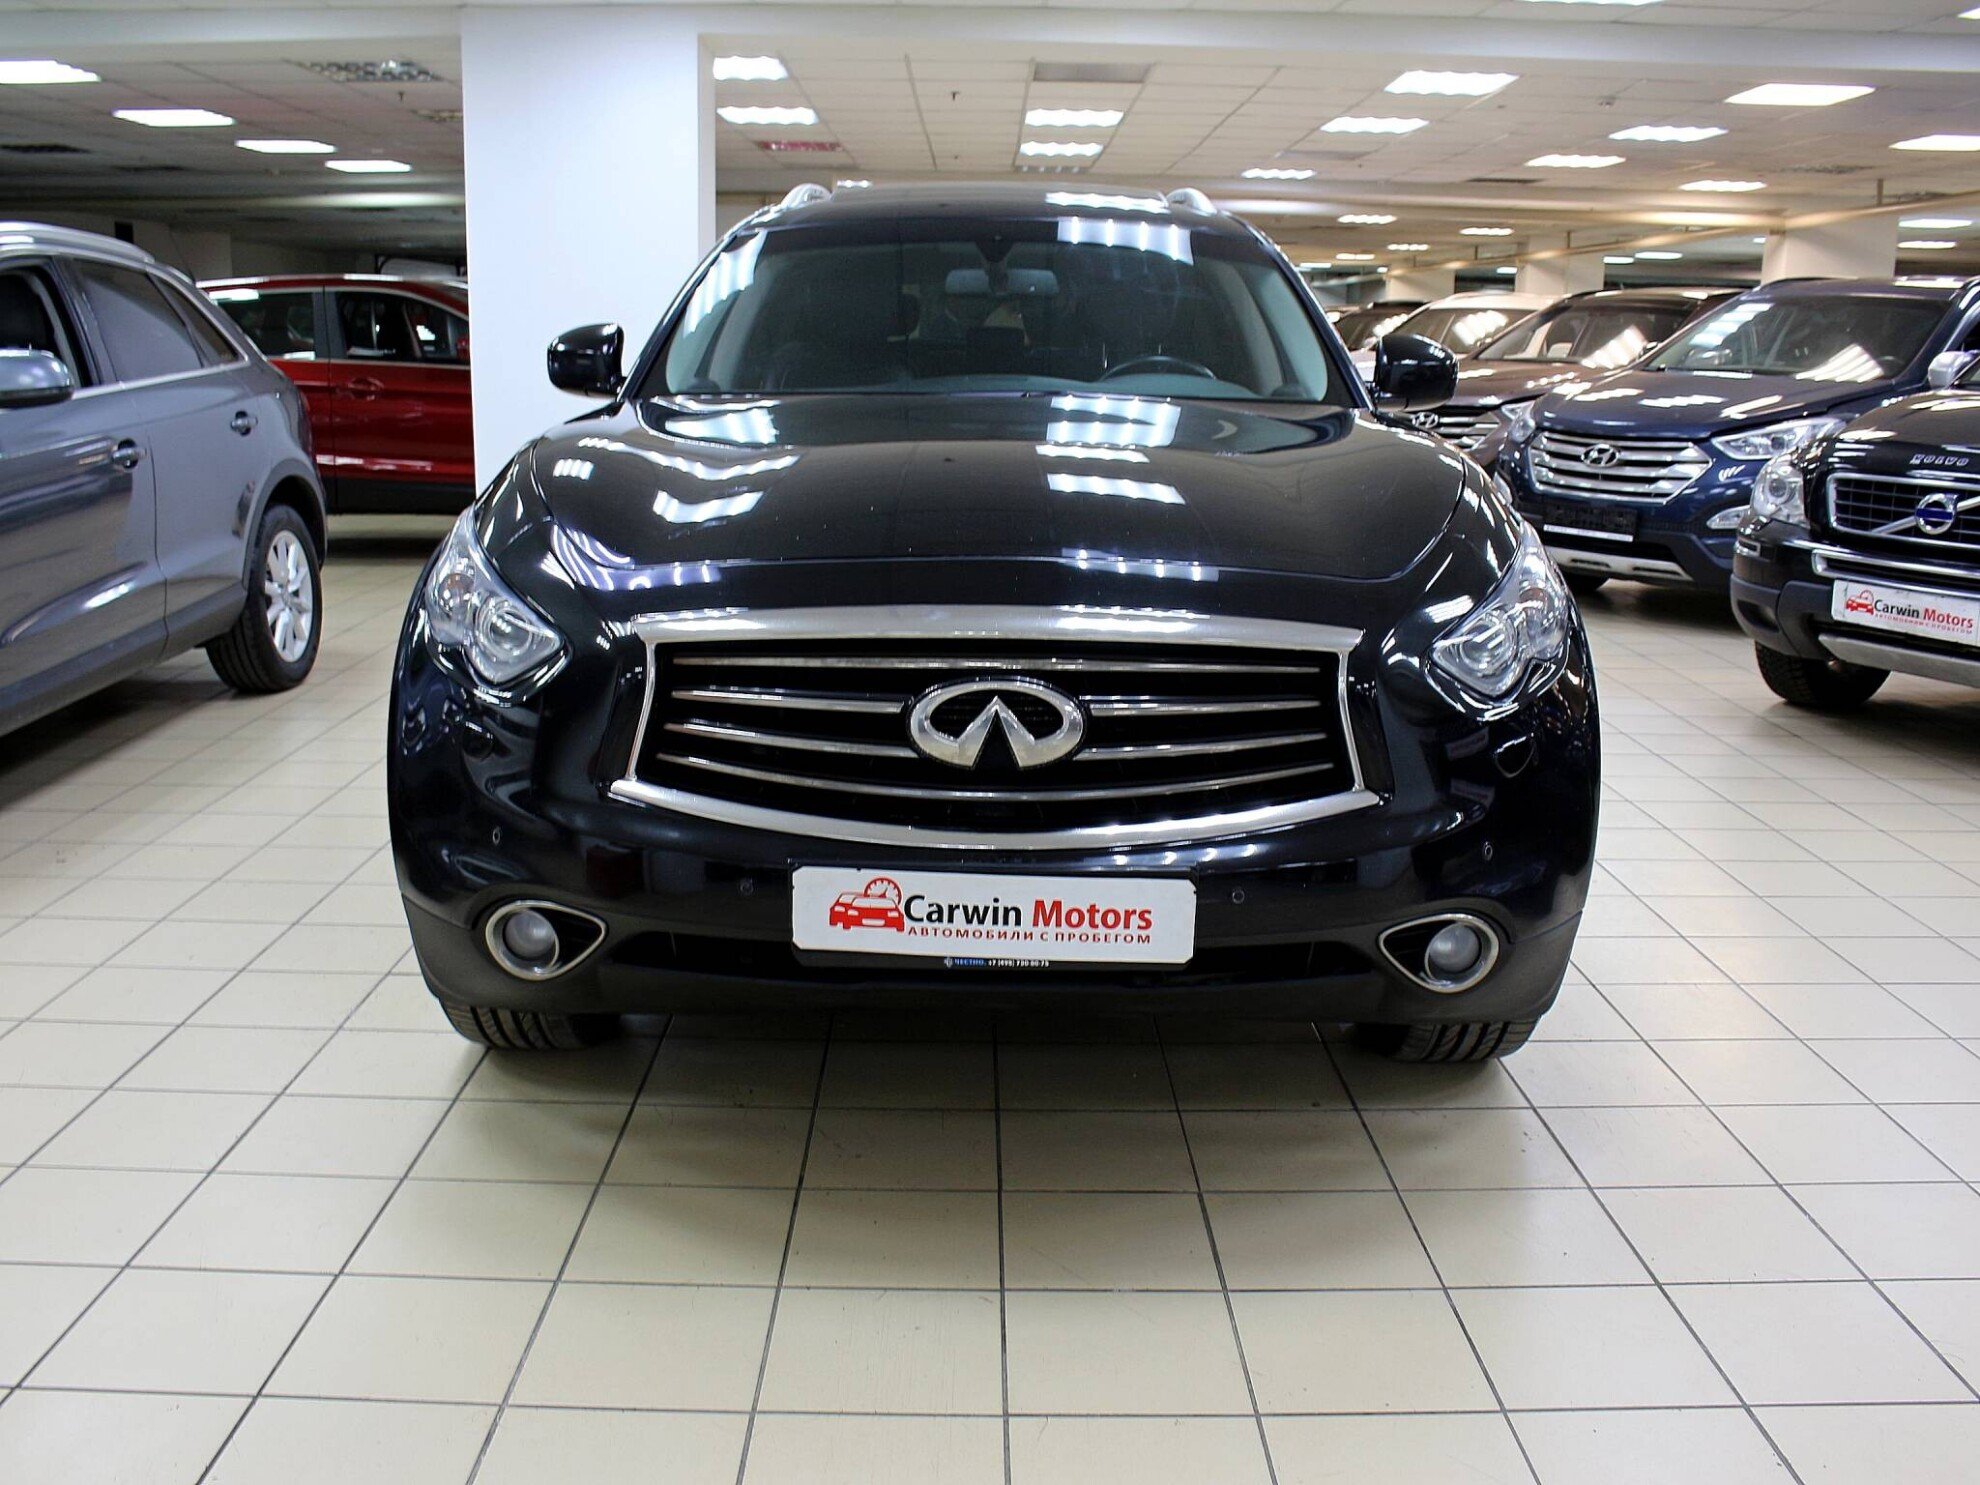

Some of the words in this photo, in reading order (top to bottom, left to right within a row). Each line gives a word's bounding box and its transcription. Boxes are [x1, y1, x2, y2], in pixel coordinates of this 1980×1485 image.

[1909, 454, 1969, 466] VOLVO
[1874, 599, 1920, 619] Carwin
[1923, 608, 1973, 628] Motors
[903, 894, 1022, 926] Carwin
[1032, 898, 1152, 930] Motors
[908, 926, 1033, 941] АВТОМОБИЛИ
[1040, 931, 1048, 942] С
[1055, 932, 1151, 944] ПРОБЕГОМ
